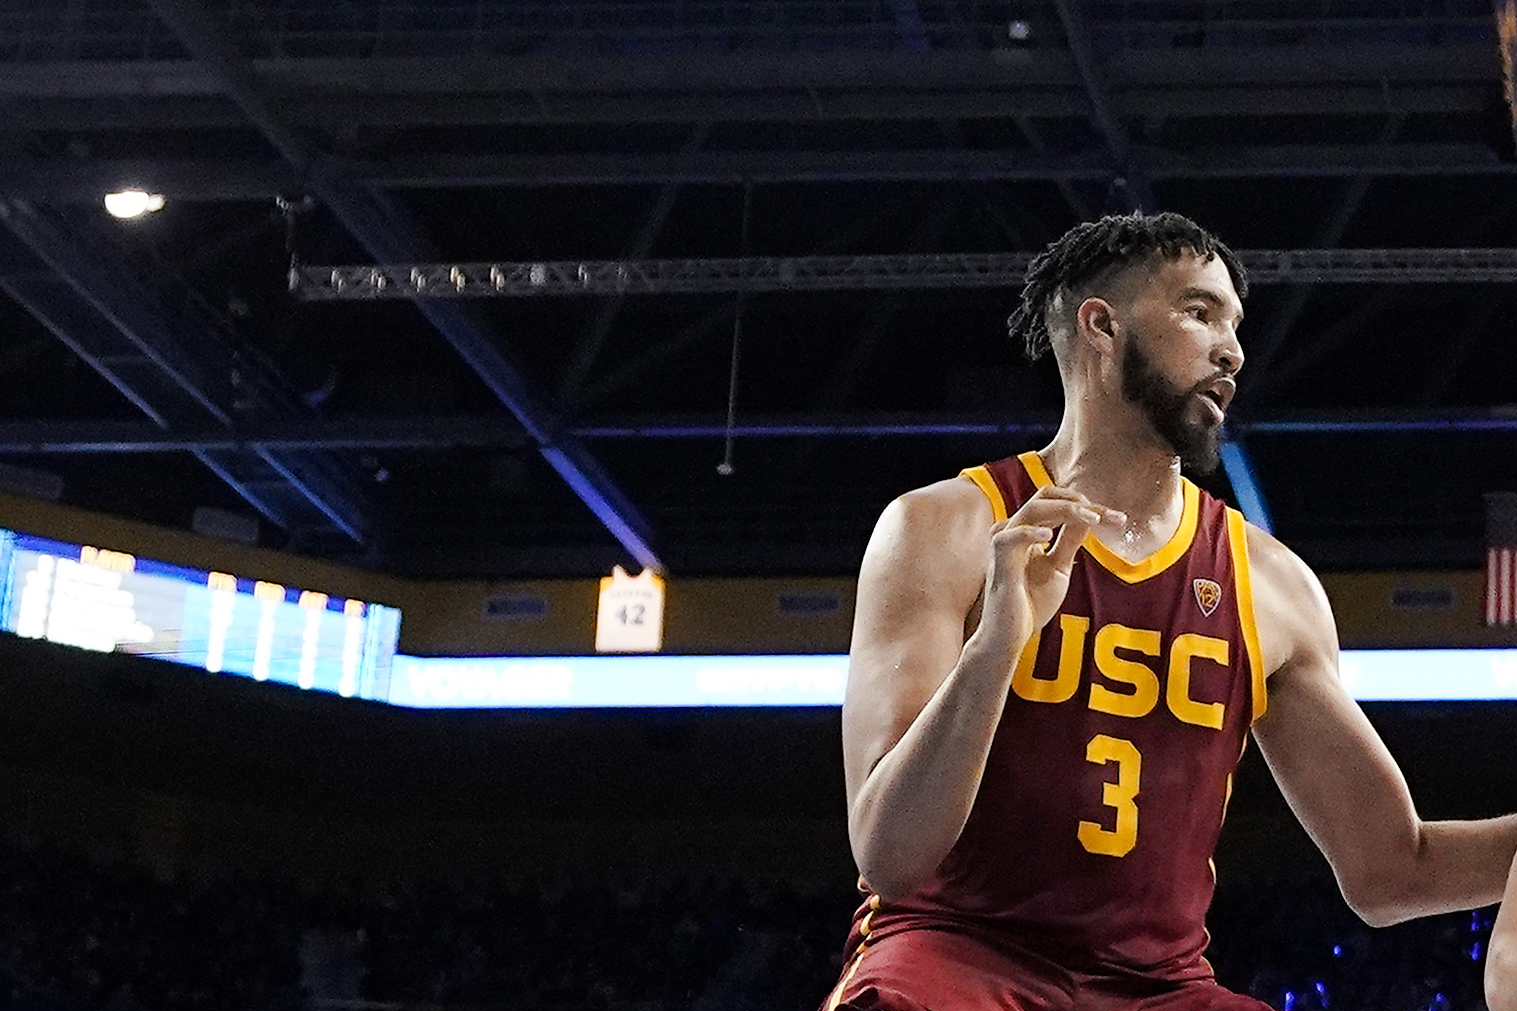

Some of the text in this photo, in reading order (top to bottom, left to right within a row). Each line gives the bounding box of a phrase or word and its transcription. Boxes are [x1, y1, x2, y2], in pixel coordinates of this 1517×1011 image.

[615, 604, 646, 625] 42
[407, 663, 574, 700] VOYAGER
[1012, 613, 1230, 731] USC
[1077, 734, 1142, 858] 3
